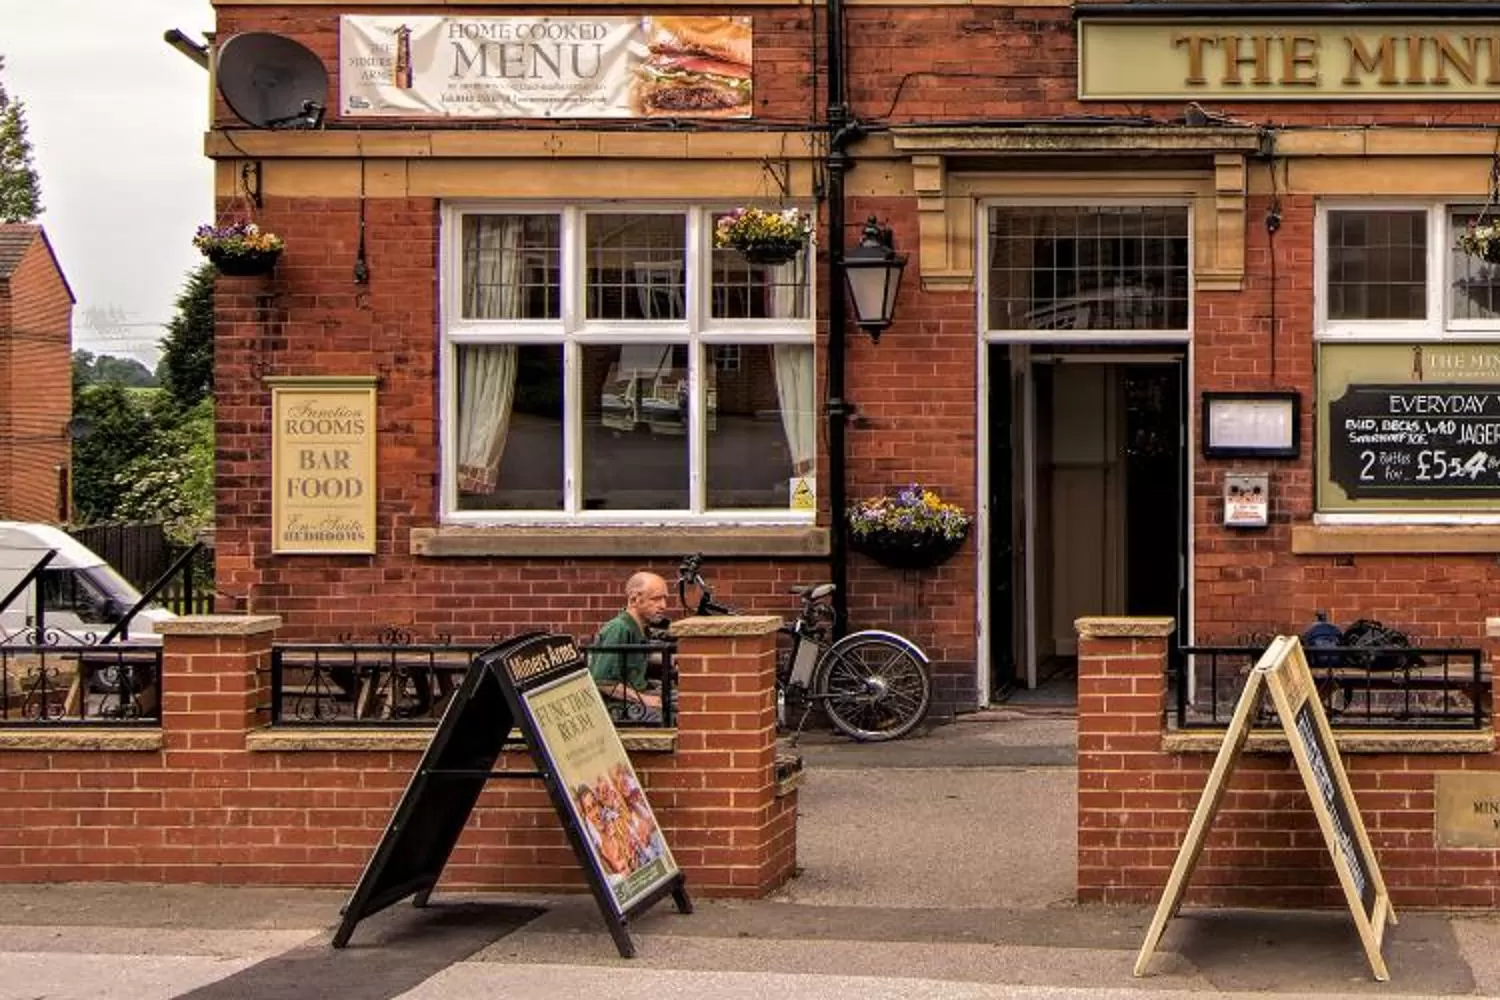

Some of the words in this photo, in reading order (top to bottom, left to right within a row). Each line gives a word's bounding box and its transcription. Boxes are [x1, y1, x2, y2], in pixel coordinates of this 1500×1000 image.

[449, 23, 512, 39] HOME
[515, 23, 608, 39] COOKED
[450, 41, 604, 79] MENU
[1171, 31, 1320, 87] THE
[1430, 352, 1465, 369] THE
[287, 399, 363, 419] Function
[1389, 395, 1489, 413] EVERYDAY
[286, 419, 366, 435] ROOMS
[300, 449, 351, 470] BAR
[1359, 450, 1375, 480] 2
[287, 477, 364, 499] FOOD
[509, 650, 550, 680] Miners
[547, 642, 577, 665] Arms
[534, 687, 595, 727] FUNCTION
[556, 711, 595, 743] ROOM
